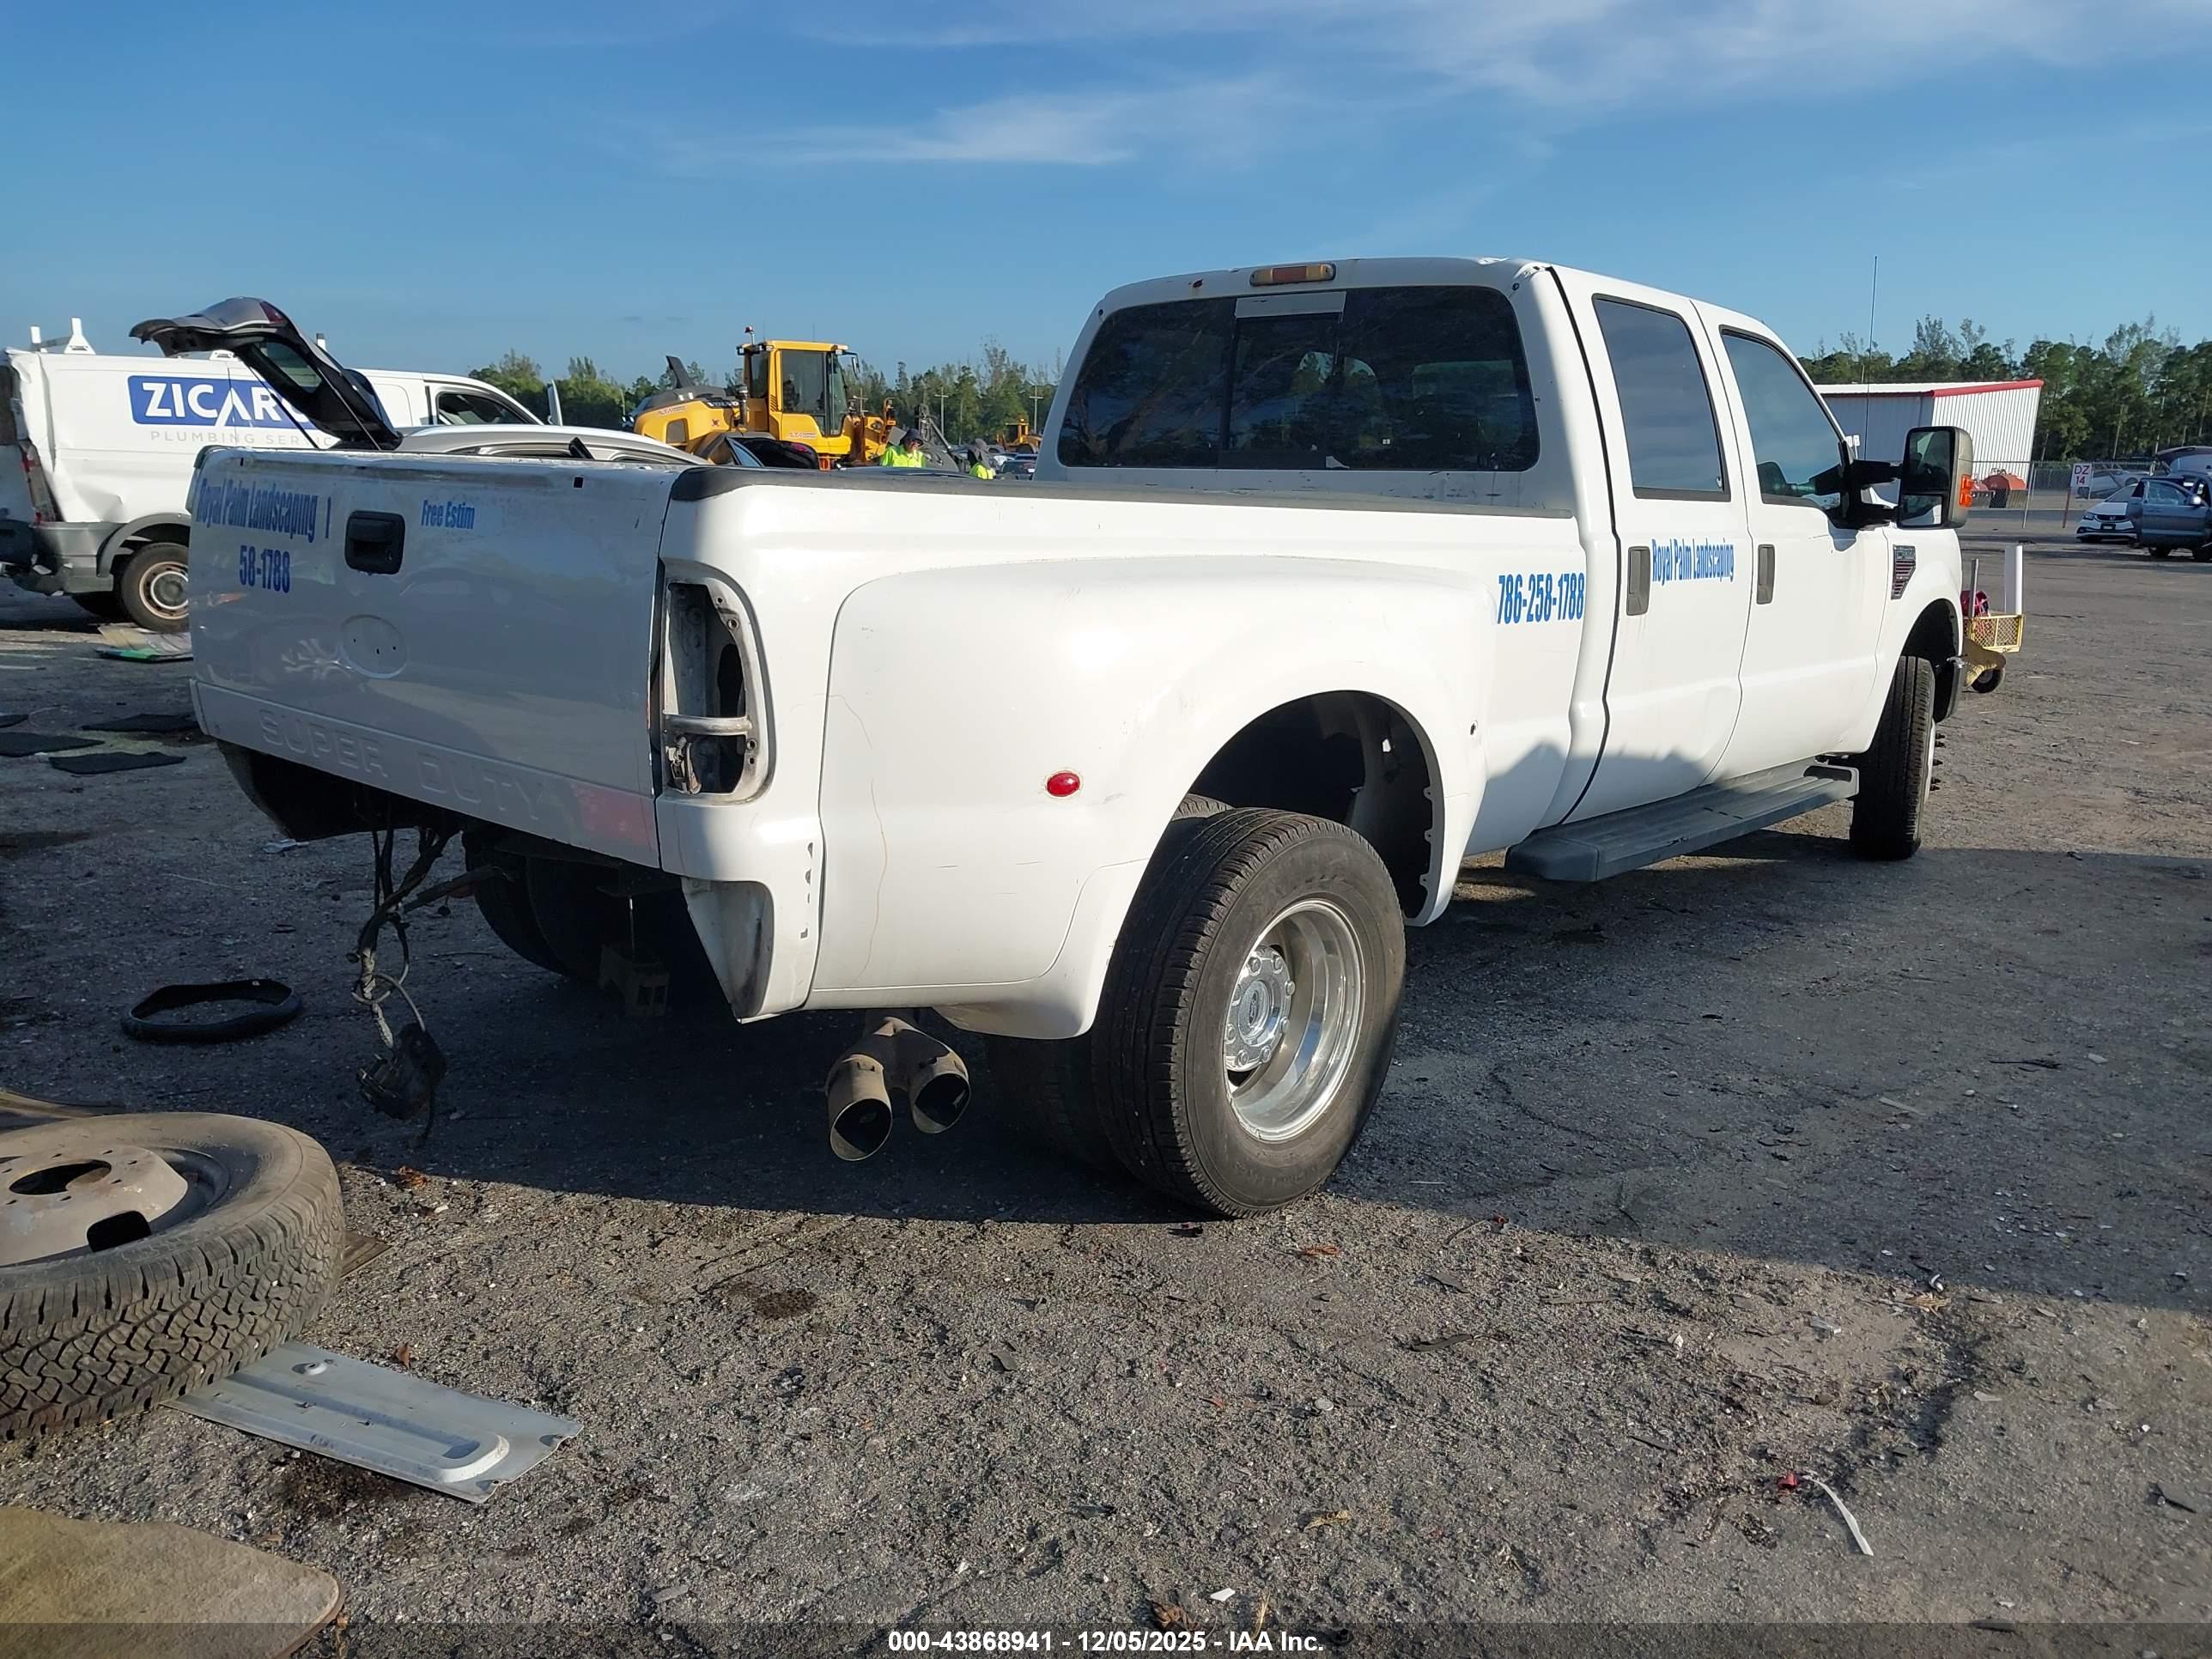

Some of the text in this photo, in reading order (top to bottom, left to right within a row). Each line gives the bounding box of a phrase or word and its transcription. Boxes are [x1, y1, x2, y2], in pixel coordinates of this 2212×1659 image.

[150, 431, 255, 445] PLUMBING
[2074, 465, 2090, 475] DZ
[2075, 476, 2086, 485] 14
[196, 477, 226, 528] Royal
[224, 479, 250, 528] Palm
[247, 480, 319, 544] Landscaping
[420, 500, 475, 530] Free Estim
[240, 544, 291, 593] 58-1788
[1651, 537, 1735, 586] Royal Palm Landscaping
[1497, 572, 1586, 624] 786-258-1788
[258, 708, 550, 821] SUPER DUTY
